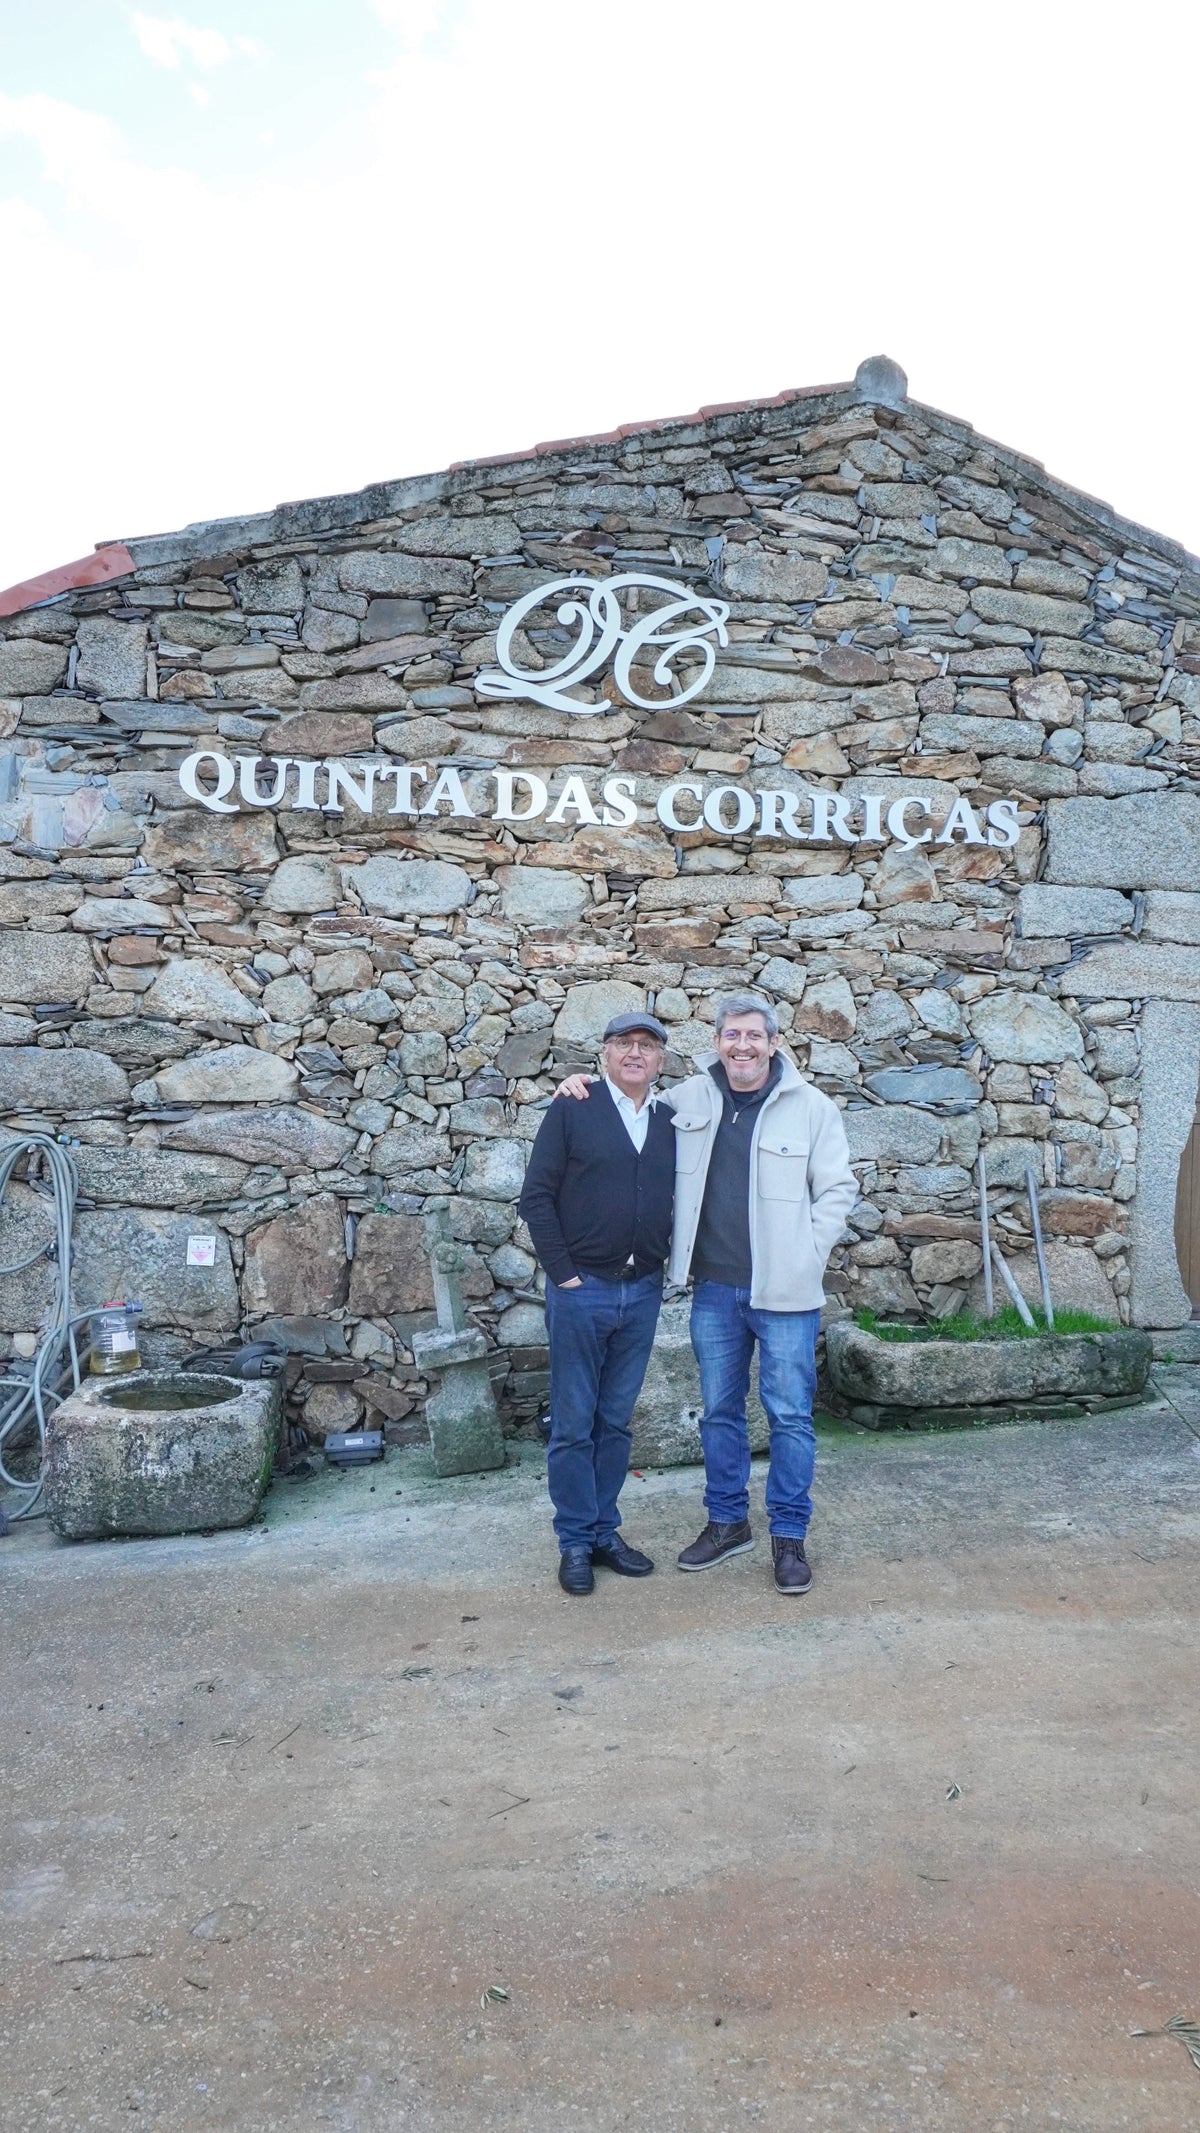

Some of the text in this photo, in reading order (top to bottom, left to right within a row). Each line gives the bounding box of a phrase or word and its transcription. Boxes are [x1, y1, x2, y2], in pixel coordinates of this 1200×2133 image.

[179, 751, 1021, 853] QUINTA DAS CORRIÇAS
